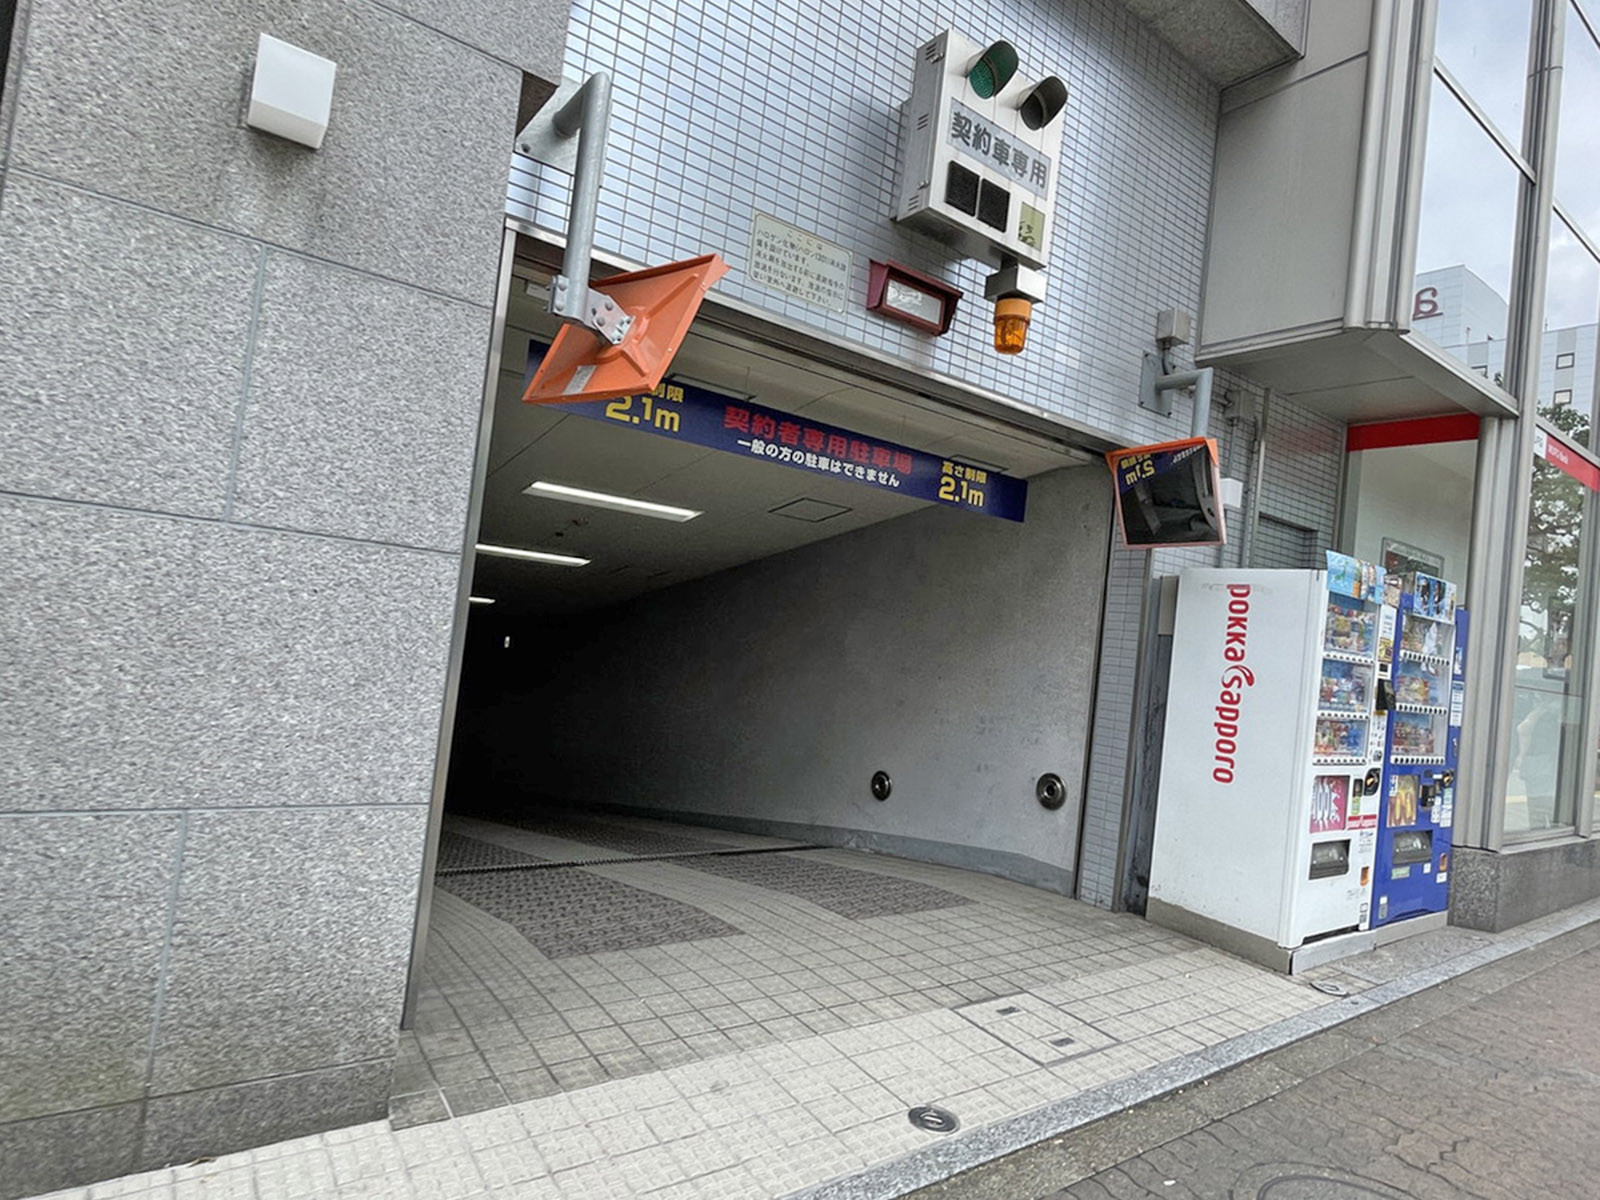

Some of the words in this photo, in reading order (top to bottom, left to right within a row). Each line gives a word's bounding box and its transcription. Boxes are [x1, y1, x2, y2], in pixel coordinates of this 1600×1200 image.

[951, 111, 1048, 189] 契約車専用
[606, 396, 680, 432] 2.1m
[723, 405, 913, 476] 契約者専用駐車場
[737, 438, 900, 488] 一般の方の駐車はできません
[939, 475, 984, 507] 2.1m
